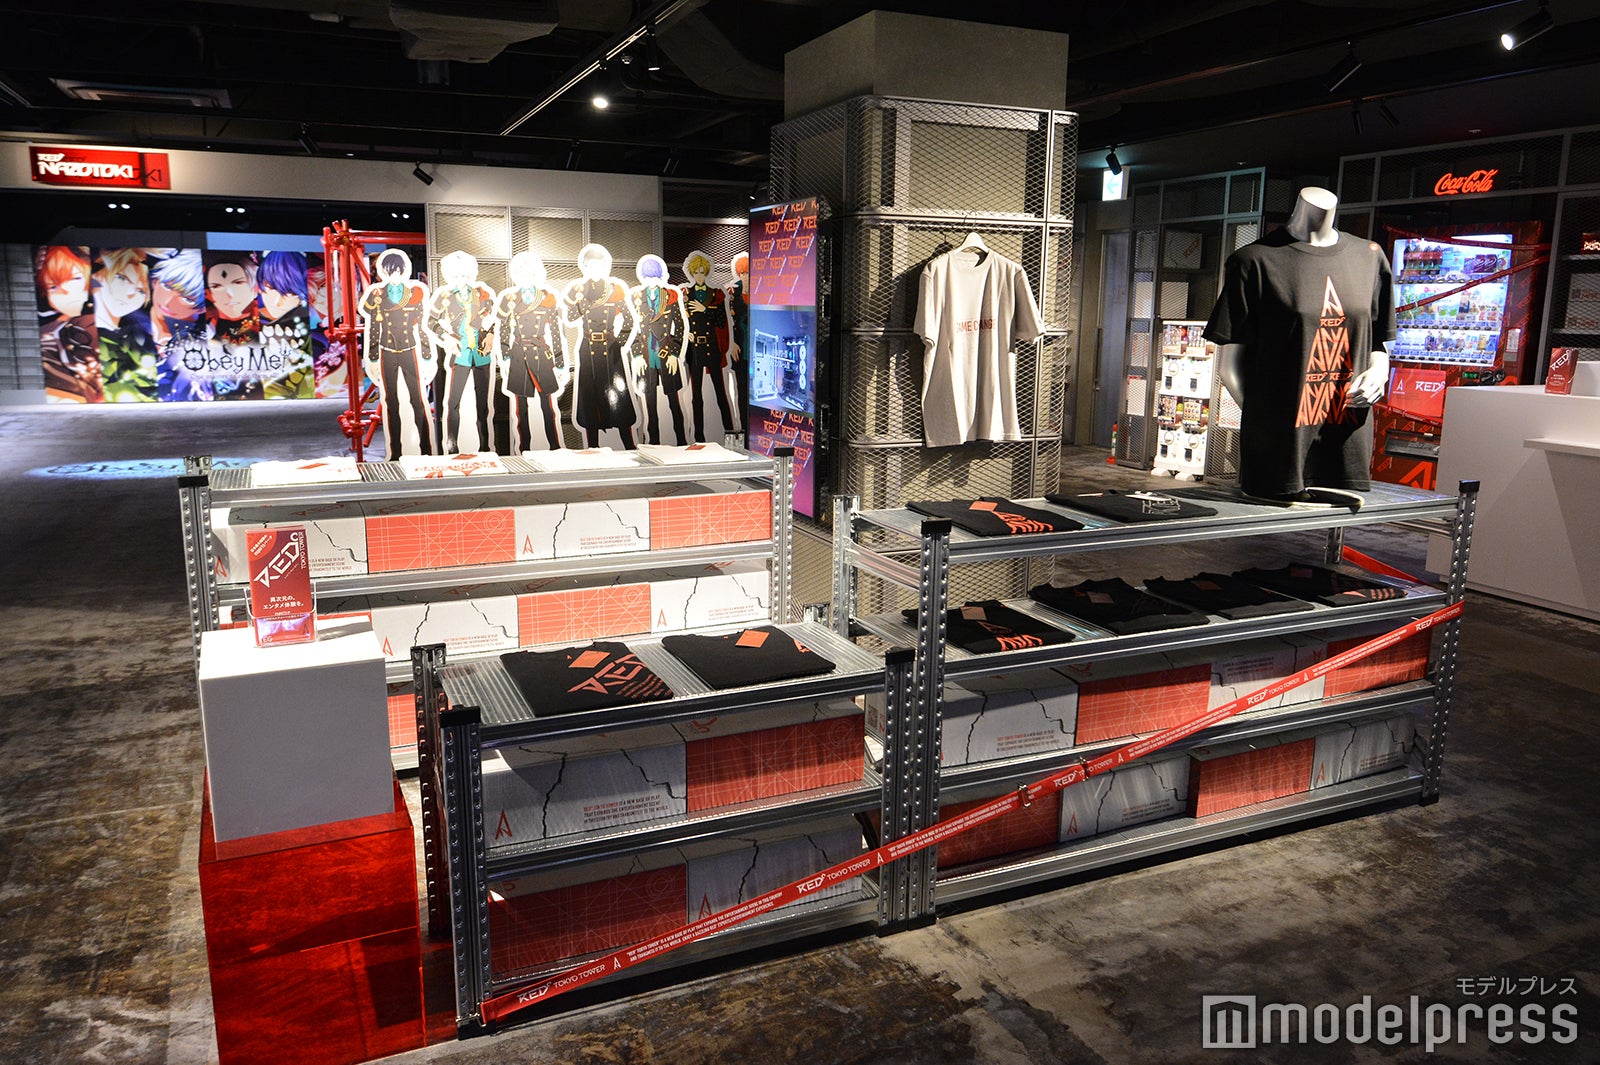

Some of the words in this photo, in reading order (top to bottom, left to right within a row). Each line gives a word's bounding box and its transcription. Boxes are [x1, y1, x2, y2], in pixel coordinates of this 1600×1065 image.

[37, 161, 134, 179] NAZOTOKI
[1434, 169, 1499, 196] Coca-Cola
[183, 344, 244, 375] Obey
[826, 867, 848, 880] TOKYO
[847, 858, 871, 872] TOWER
[552, 974, 578, 988] TOKYO
[578, 963, 606, 979] TOWER
